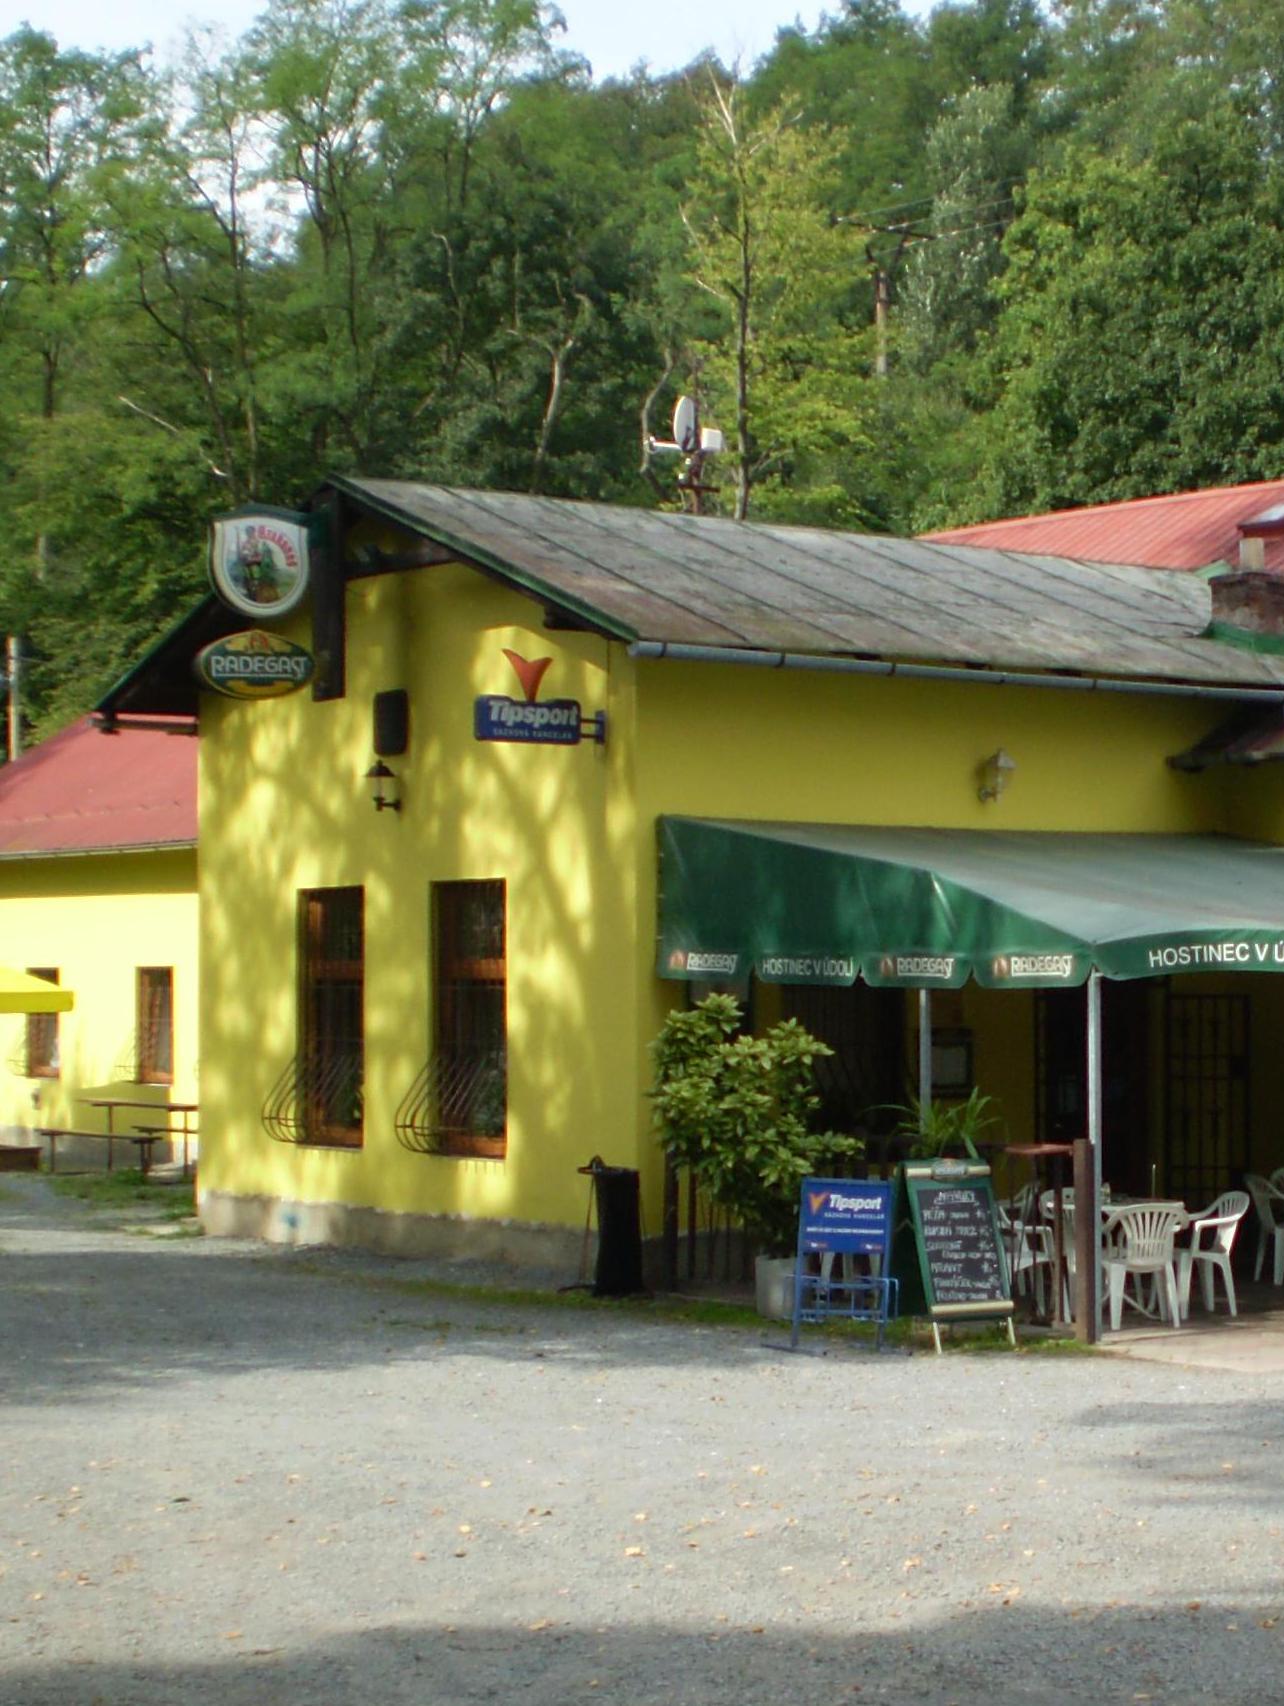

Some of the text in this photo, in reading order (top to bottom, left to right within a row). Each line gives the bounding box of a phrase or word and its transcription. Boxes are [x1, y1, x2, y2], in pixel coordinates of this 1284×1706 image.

[210, 656, 308, 680] RADEGAST
[489, 700, 578, 729] Tipsport
[762, 957, 812, 975] HOSTINEC
[814, 959, 821, 975] V
[1011, 955, 1073, 978] RADEGAST
[1149, 943, 1250, 968] HOSTINEC
[1254, 943, 1269, 961] V
[897, 957, 955, 979] RADEGAST
[829, 1194, 882, 1212] Tipsport
